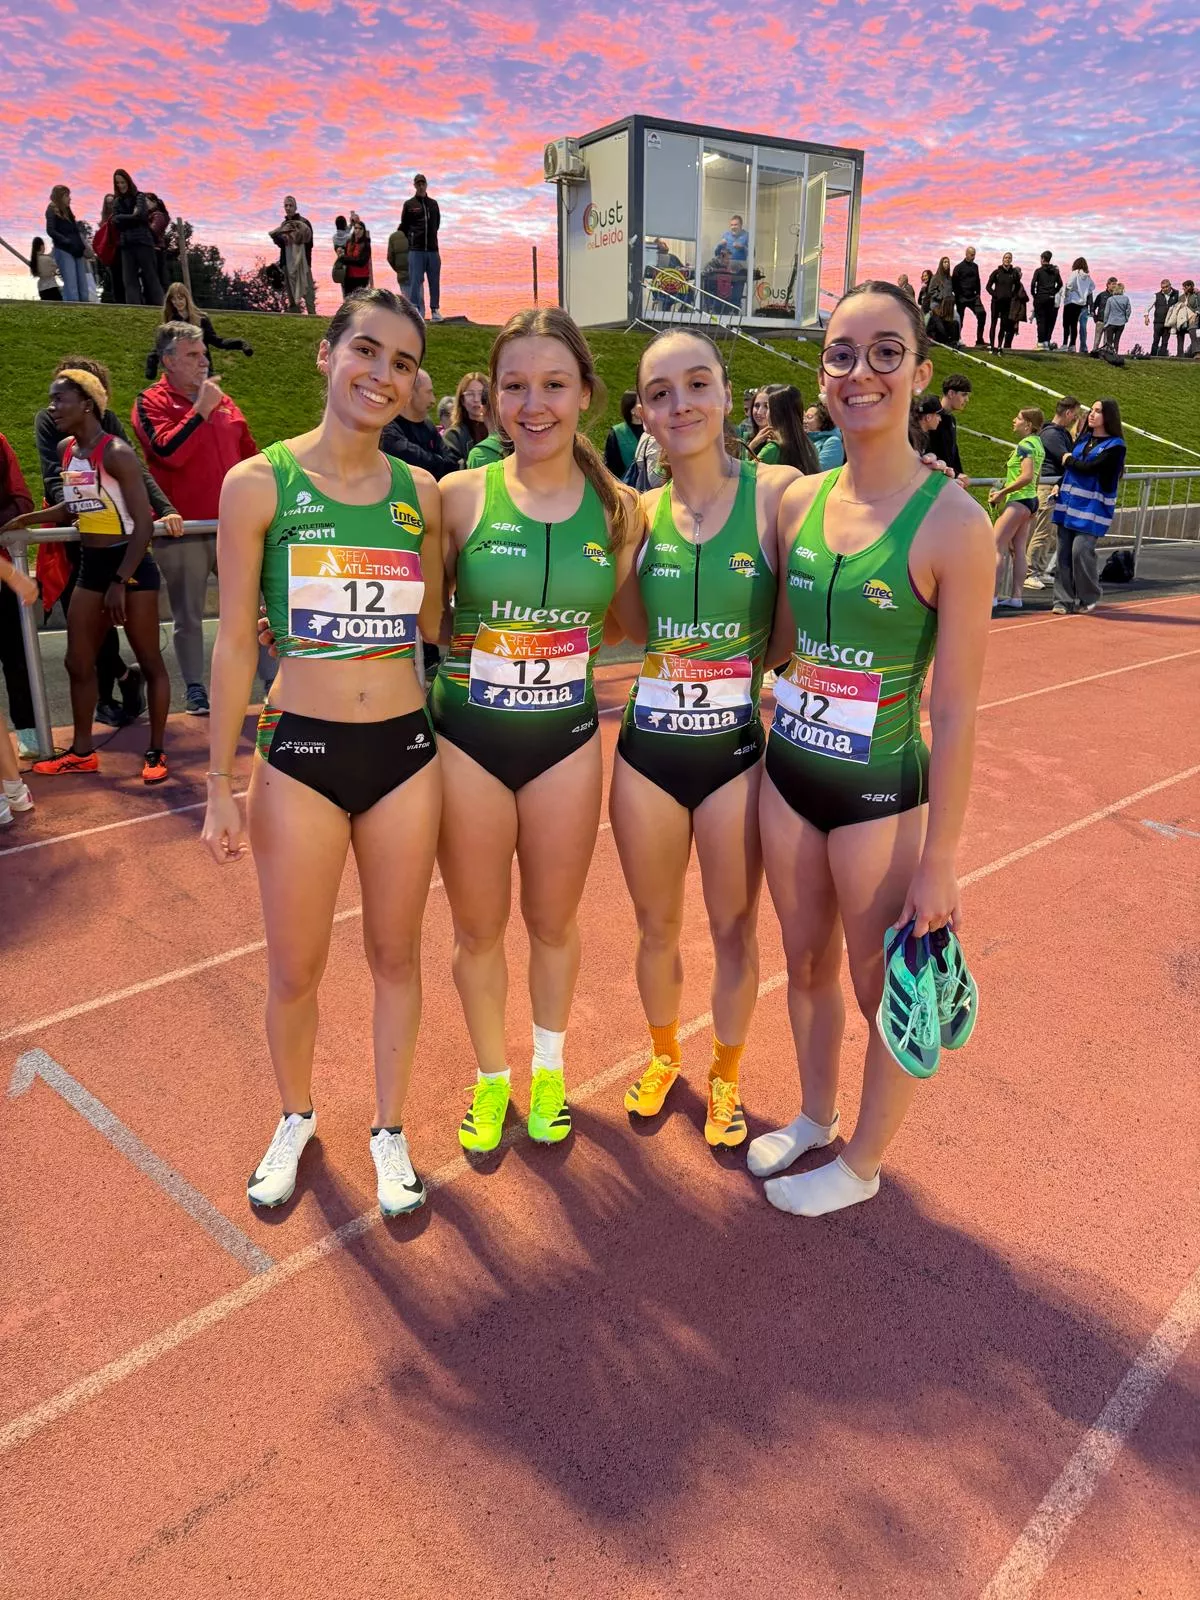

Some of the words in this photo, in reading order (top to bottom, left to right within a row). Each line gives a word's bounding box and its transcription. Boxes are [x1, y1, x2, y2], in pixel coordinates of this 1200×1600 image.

[283, 505, 324, 517] VIATOR
[298, 522, 335, 530] ATLETISMO
[490, 522, 523, 533] 42K
[298, 528, 336, 540] ZOITI
[490, 544, 527, 557] ZOITI
[492, 540, 527, 548] ATLETISMO
[654, 543, 679, 553] 42K
[336, 550, 368, 563] RFEA
[795, 546, 818, 562] 42K
[342, 563, 409, 577] ATLETISMO
[652, 567, 681, 579] ZOITI
[342, 580, 385, 612] 12
[491, 600, 592, 624] Huesca
[657, 616, 740, 639] Huesca
[514, 642, 575, 656] ATLETISMO
[797, 628, 874, 667] Huesca
[513, 658, 551, 685] 12
[671, 667, 734, 678] ATLETISMO
[799, 675, 859, 697] ATLETISMO
[671, 683, 711, 708] 12
[800, 691, 830, 724] 12
[571, 719, 594, 733] 42K
[293, 746, 326, 754] ZOITI
[406, 741, 431, 751] VIATOR
[733, 742, 757, 756] 42K
[861, 792, 898, 802] 42K
